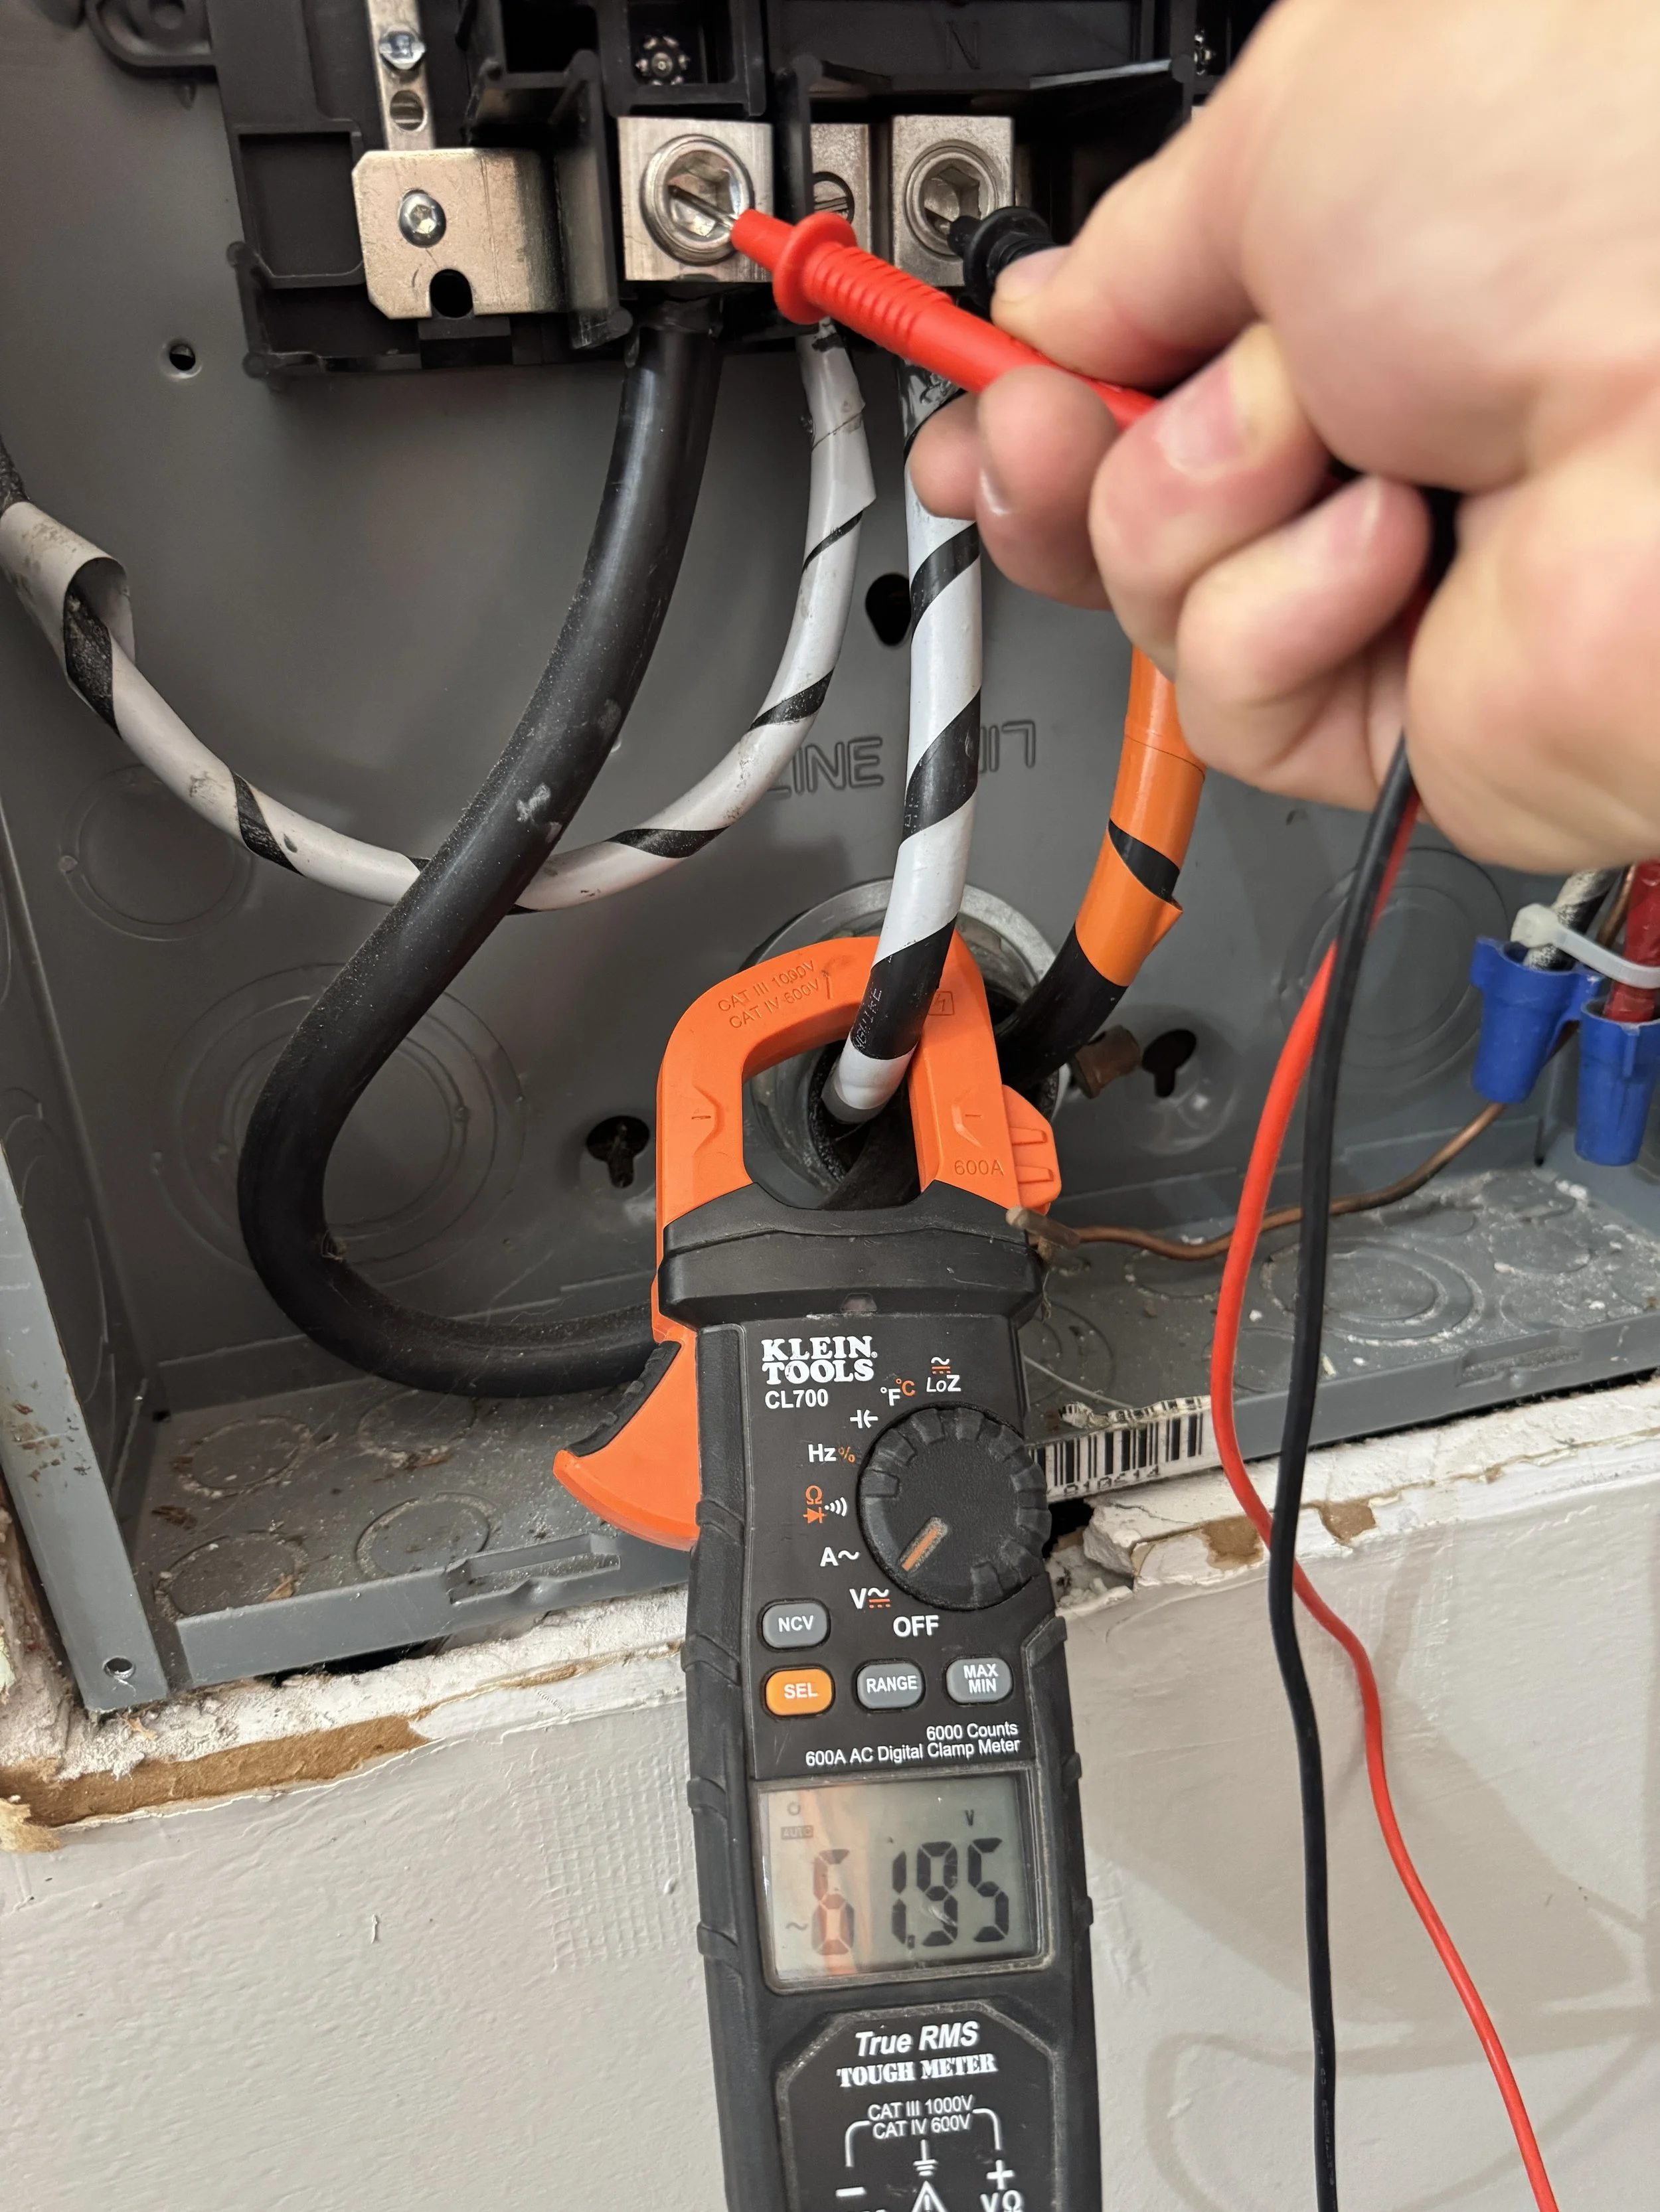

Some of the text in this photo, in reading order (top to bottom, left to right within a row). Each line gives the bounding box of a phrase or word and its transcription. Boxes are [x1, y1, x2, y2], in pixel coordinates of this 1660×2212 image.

[718, 960, 815, 1012] CAT III 1000V
[729, 978, 821, 1029] CAT IV 600V
[954, 1159, 1005, 1176] 600A
[761, 1336, 873, 1362] KLEIN
[762, 1359, 874, 1385] TOOLS
[926, 1375, 961, 1392] LoZ
[765, 1388, 829, 1409] CL700
[778, 1615, 814, 1632] NCV
[893, 1615, 939, 1636] OFF
[963, 1664, 999, 1681] MAX
[784, 1682, 818, 1699] SEL
[866, 1675, 918, 1694] RANGE
[968, 1678, 997, 1694] MIN
[926, 1721, 1019, 1741] 6000 Counts
[805, 1739, 1021, 1767] 600A AC Digital Clamp Meter
[964, 1809, 975, 1826] V
[782, 1826, 814, 1840] AUTO
[855, 2020, 980, 2057] True RMS
[836, 2053, 999, 2087] TOUGH METER
[867, 2094, 975, 2121] CAT III 1000V
[872, 2113, 971, 2140] CAT IV 600V
